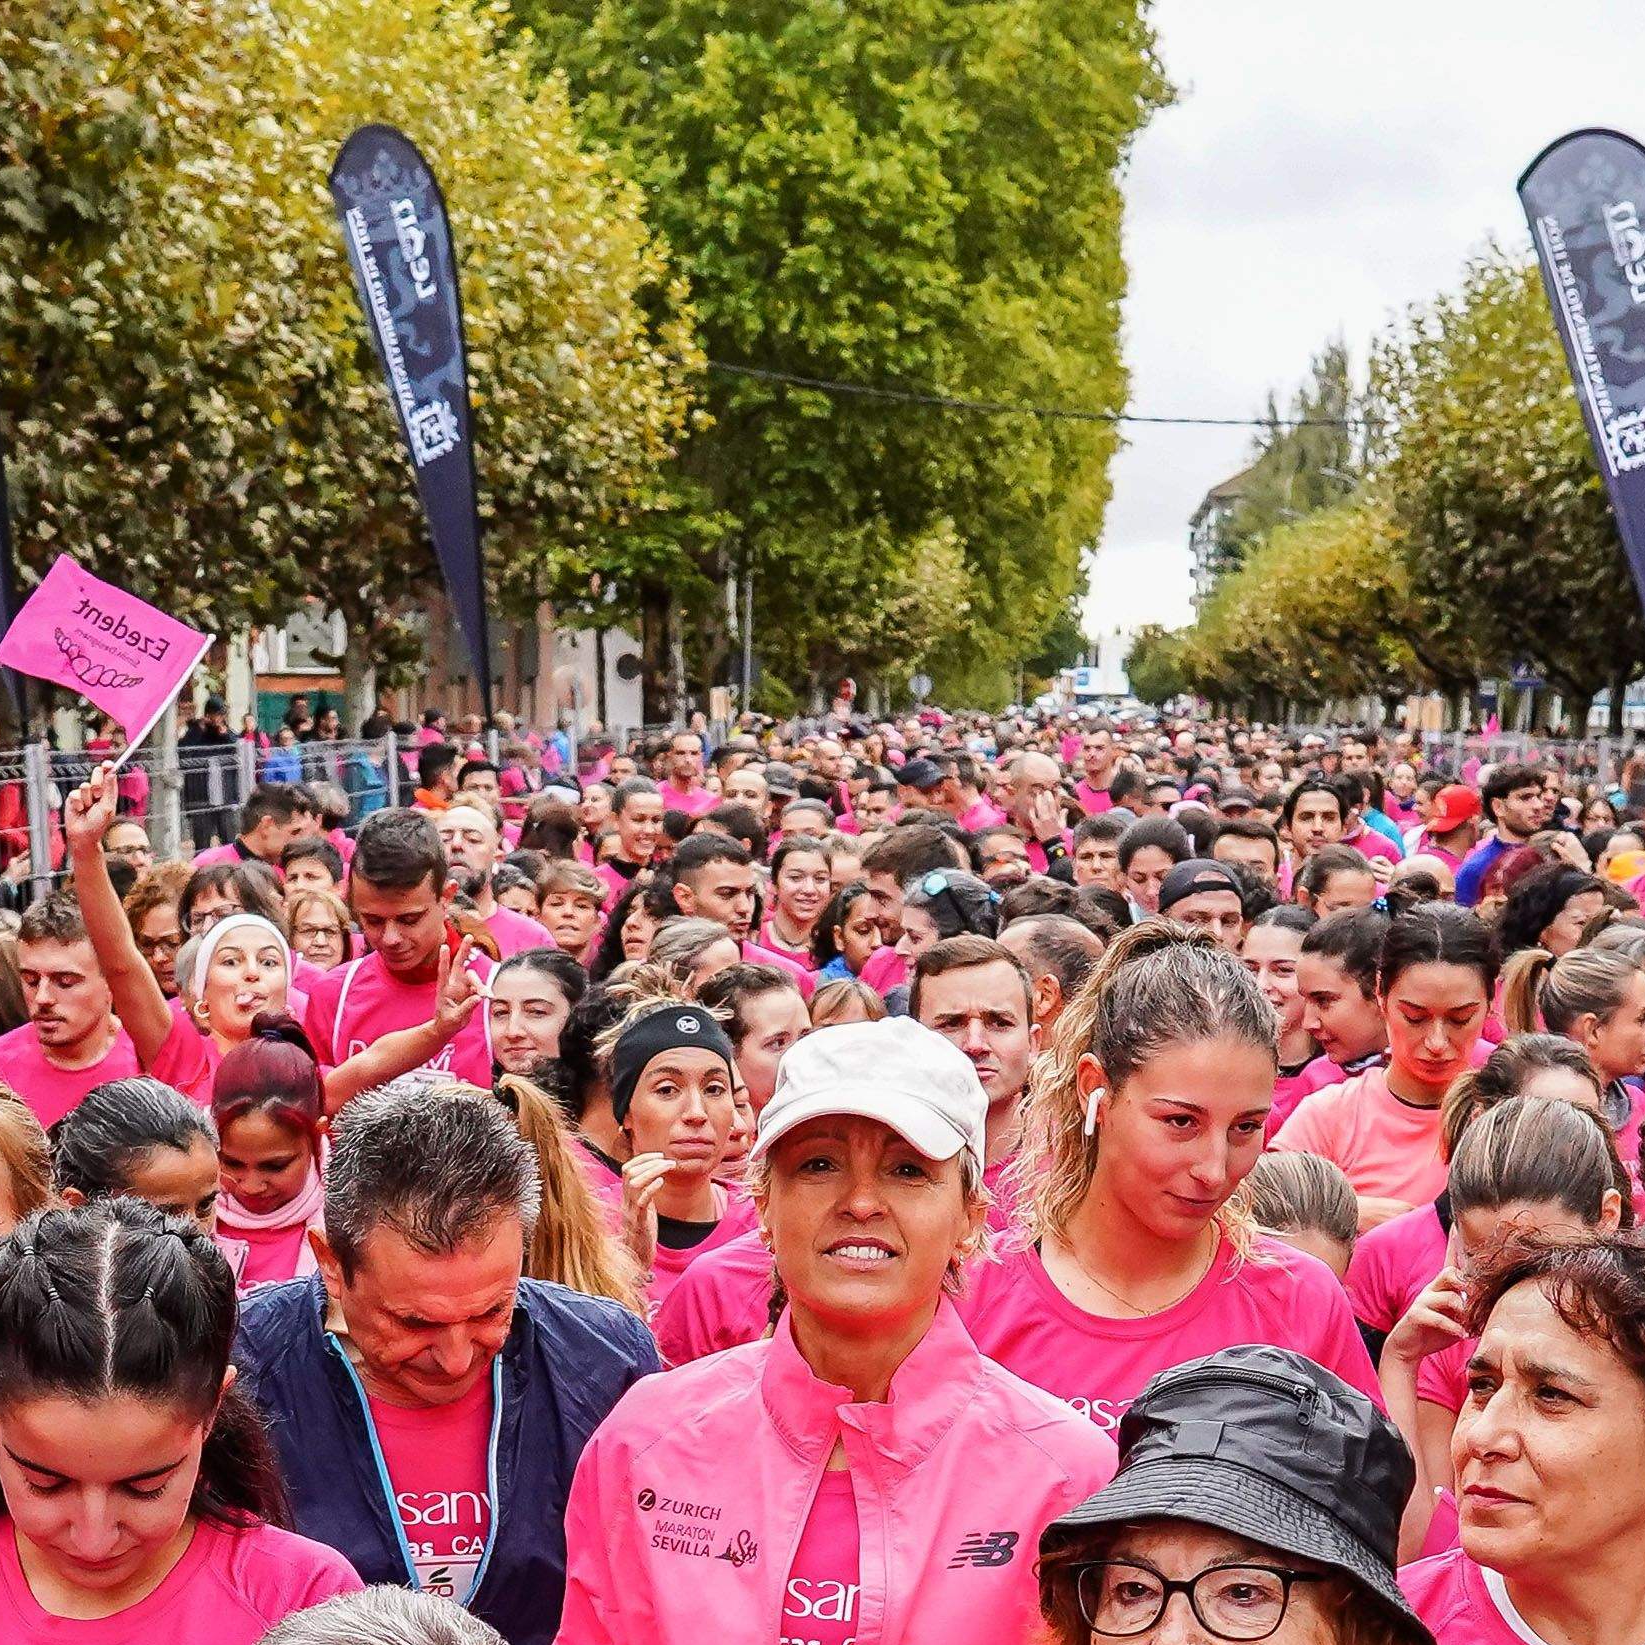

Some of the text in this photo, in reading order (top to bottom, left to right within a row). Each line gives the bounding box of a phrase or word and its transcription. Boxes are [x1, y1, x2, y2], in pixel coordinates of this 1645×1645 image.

[658, 1497, 722, 1521] ZURICH
[654, 1519, 715, 1542] MARATON
[651, 1534, 711, 1558] SEVILLA
